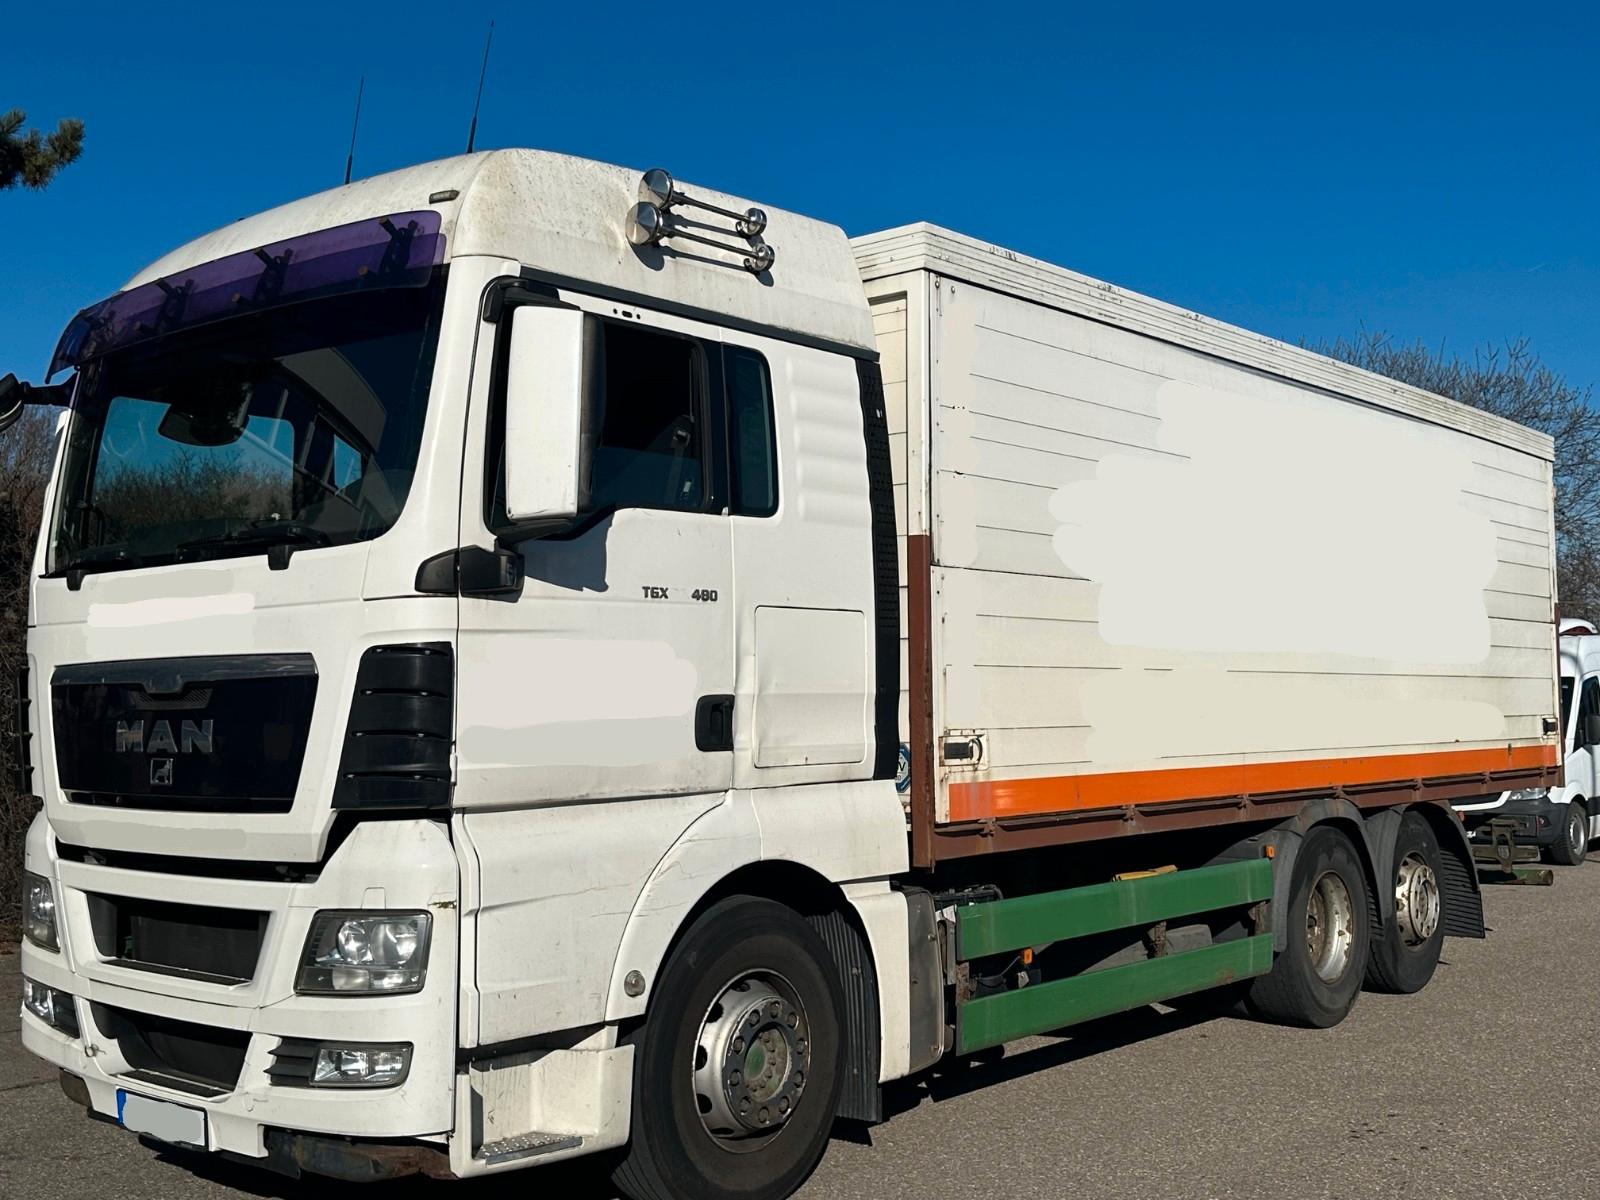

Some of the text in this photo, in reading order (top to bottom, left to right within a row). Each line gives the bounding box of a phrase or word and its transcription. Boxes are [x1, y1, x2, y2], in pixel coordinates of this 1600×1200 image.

[642, 586, 718, 602] TGX 480
[115, 719, 214, 753] MAN
